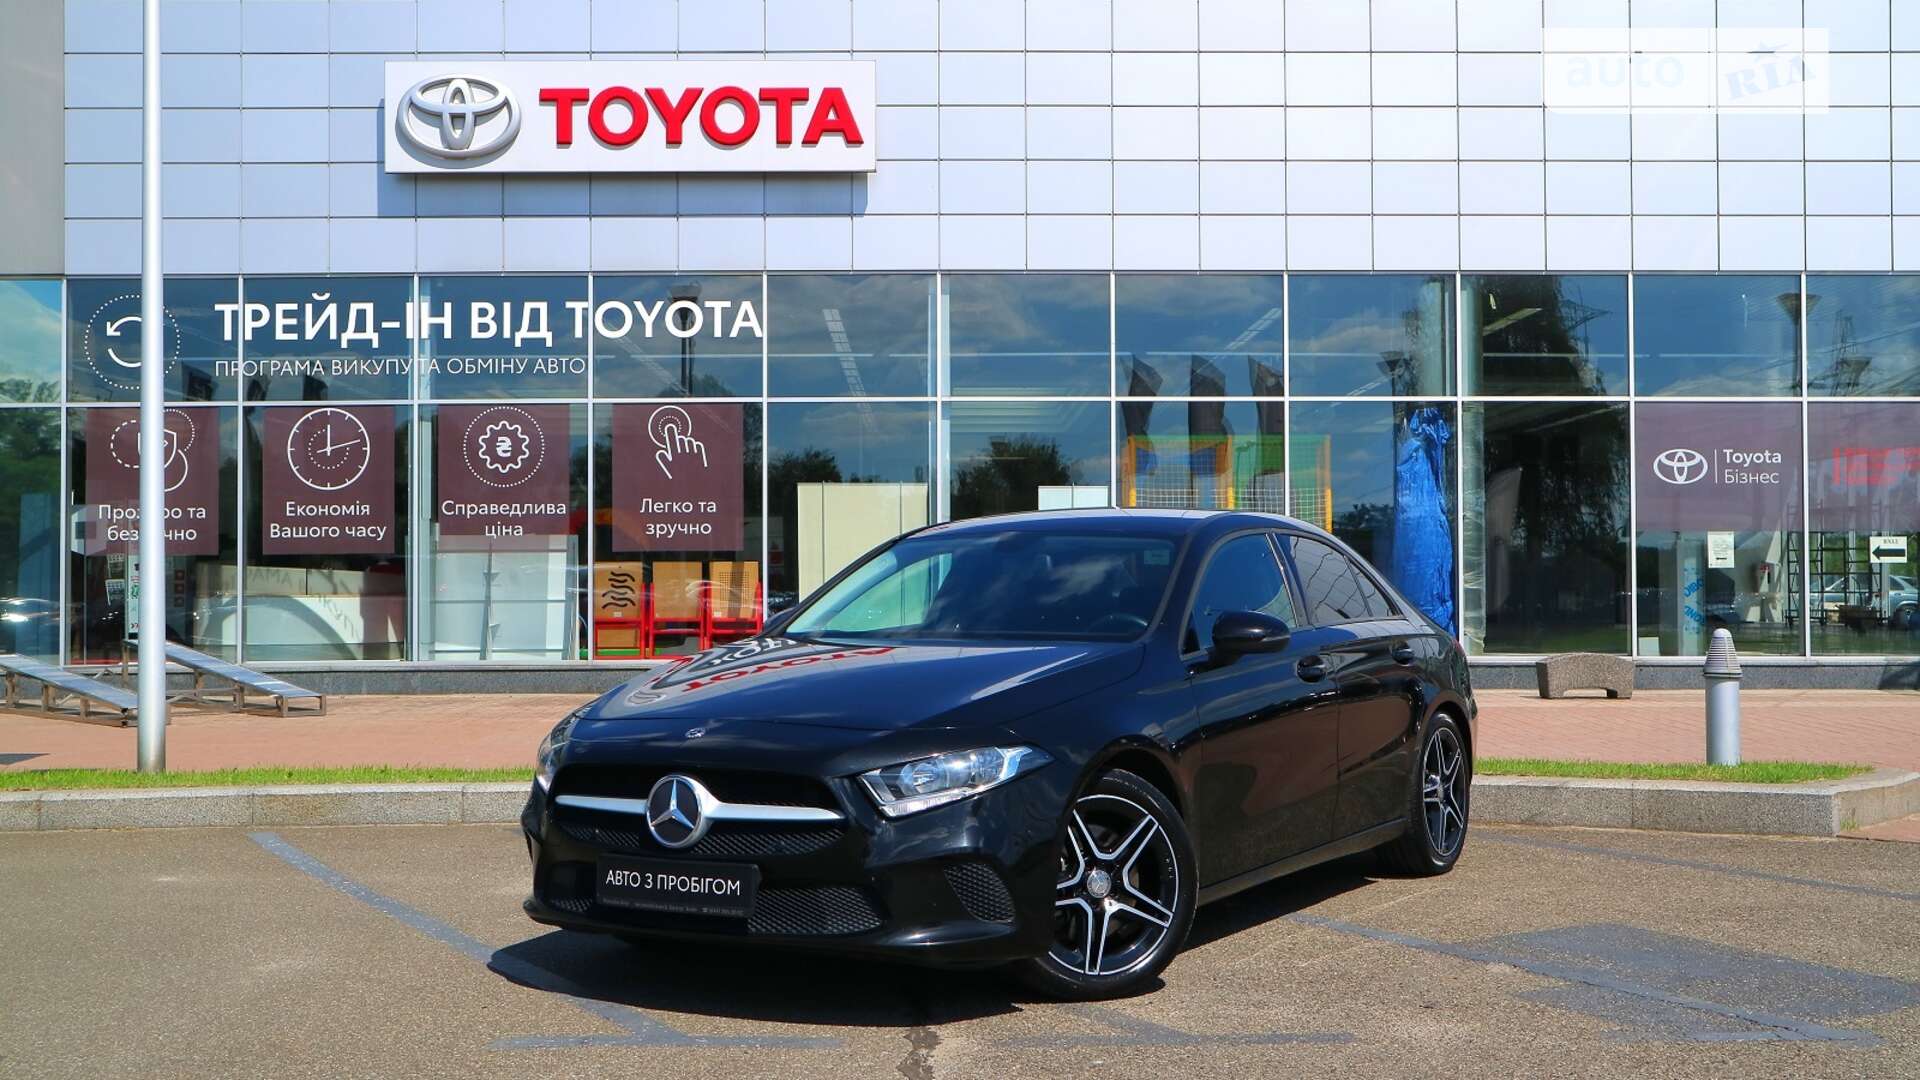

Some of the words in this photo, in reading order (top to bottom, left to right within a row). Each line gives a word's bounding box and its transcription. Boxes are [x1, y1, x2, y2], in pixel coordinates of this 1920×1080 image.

[539, 86, 864, 148] TOYOTA
[214, 292, 452, 348] ТРЕЙД-ІН
[471, 301, 553, 348] ВІД
[565, 299, 763, 339] TOYOTA
[215, 358, 325, 377] ПРОГРАМА
[331, 357, 414, 376] ВИКУПУ
[446, 356, 529, 374] ОБМІНУ
[533, 356, 587, 374] АВТО
[1722, 448, 1782, 467] Toyota
[1724, 467, 1780, 485] Бізнес
[186, 506, 206, 519] та
[285, 500, 370, 517] Економія
[441, 499, 567, 517] Справедлива
[639, 497, 694, 514] Легко
[697, 500, 718, 514] та
[269, 522, 341, 539] Вашого
[344, 524, 388, 541] часу
[485, 521, 523, 540] ціна
[645, 522, 713, 538] зручно
[605, 869, 642, 888] АВТО
[644, 872, 654, 889] З
[656, 873, 741, 897] ПРОБІГОМ
